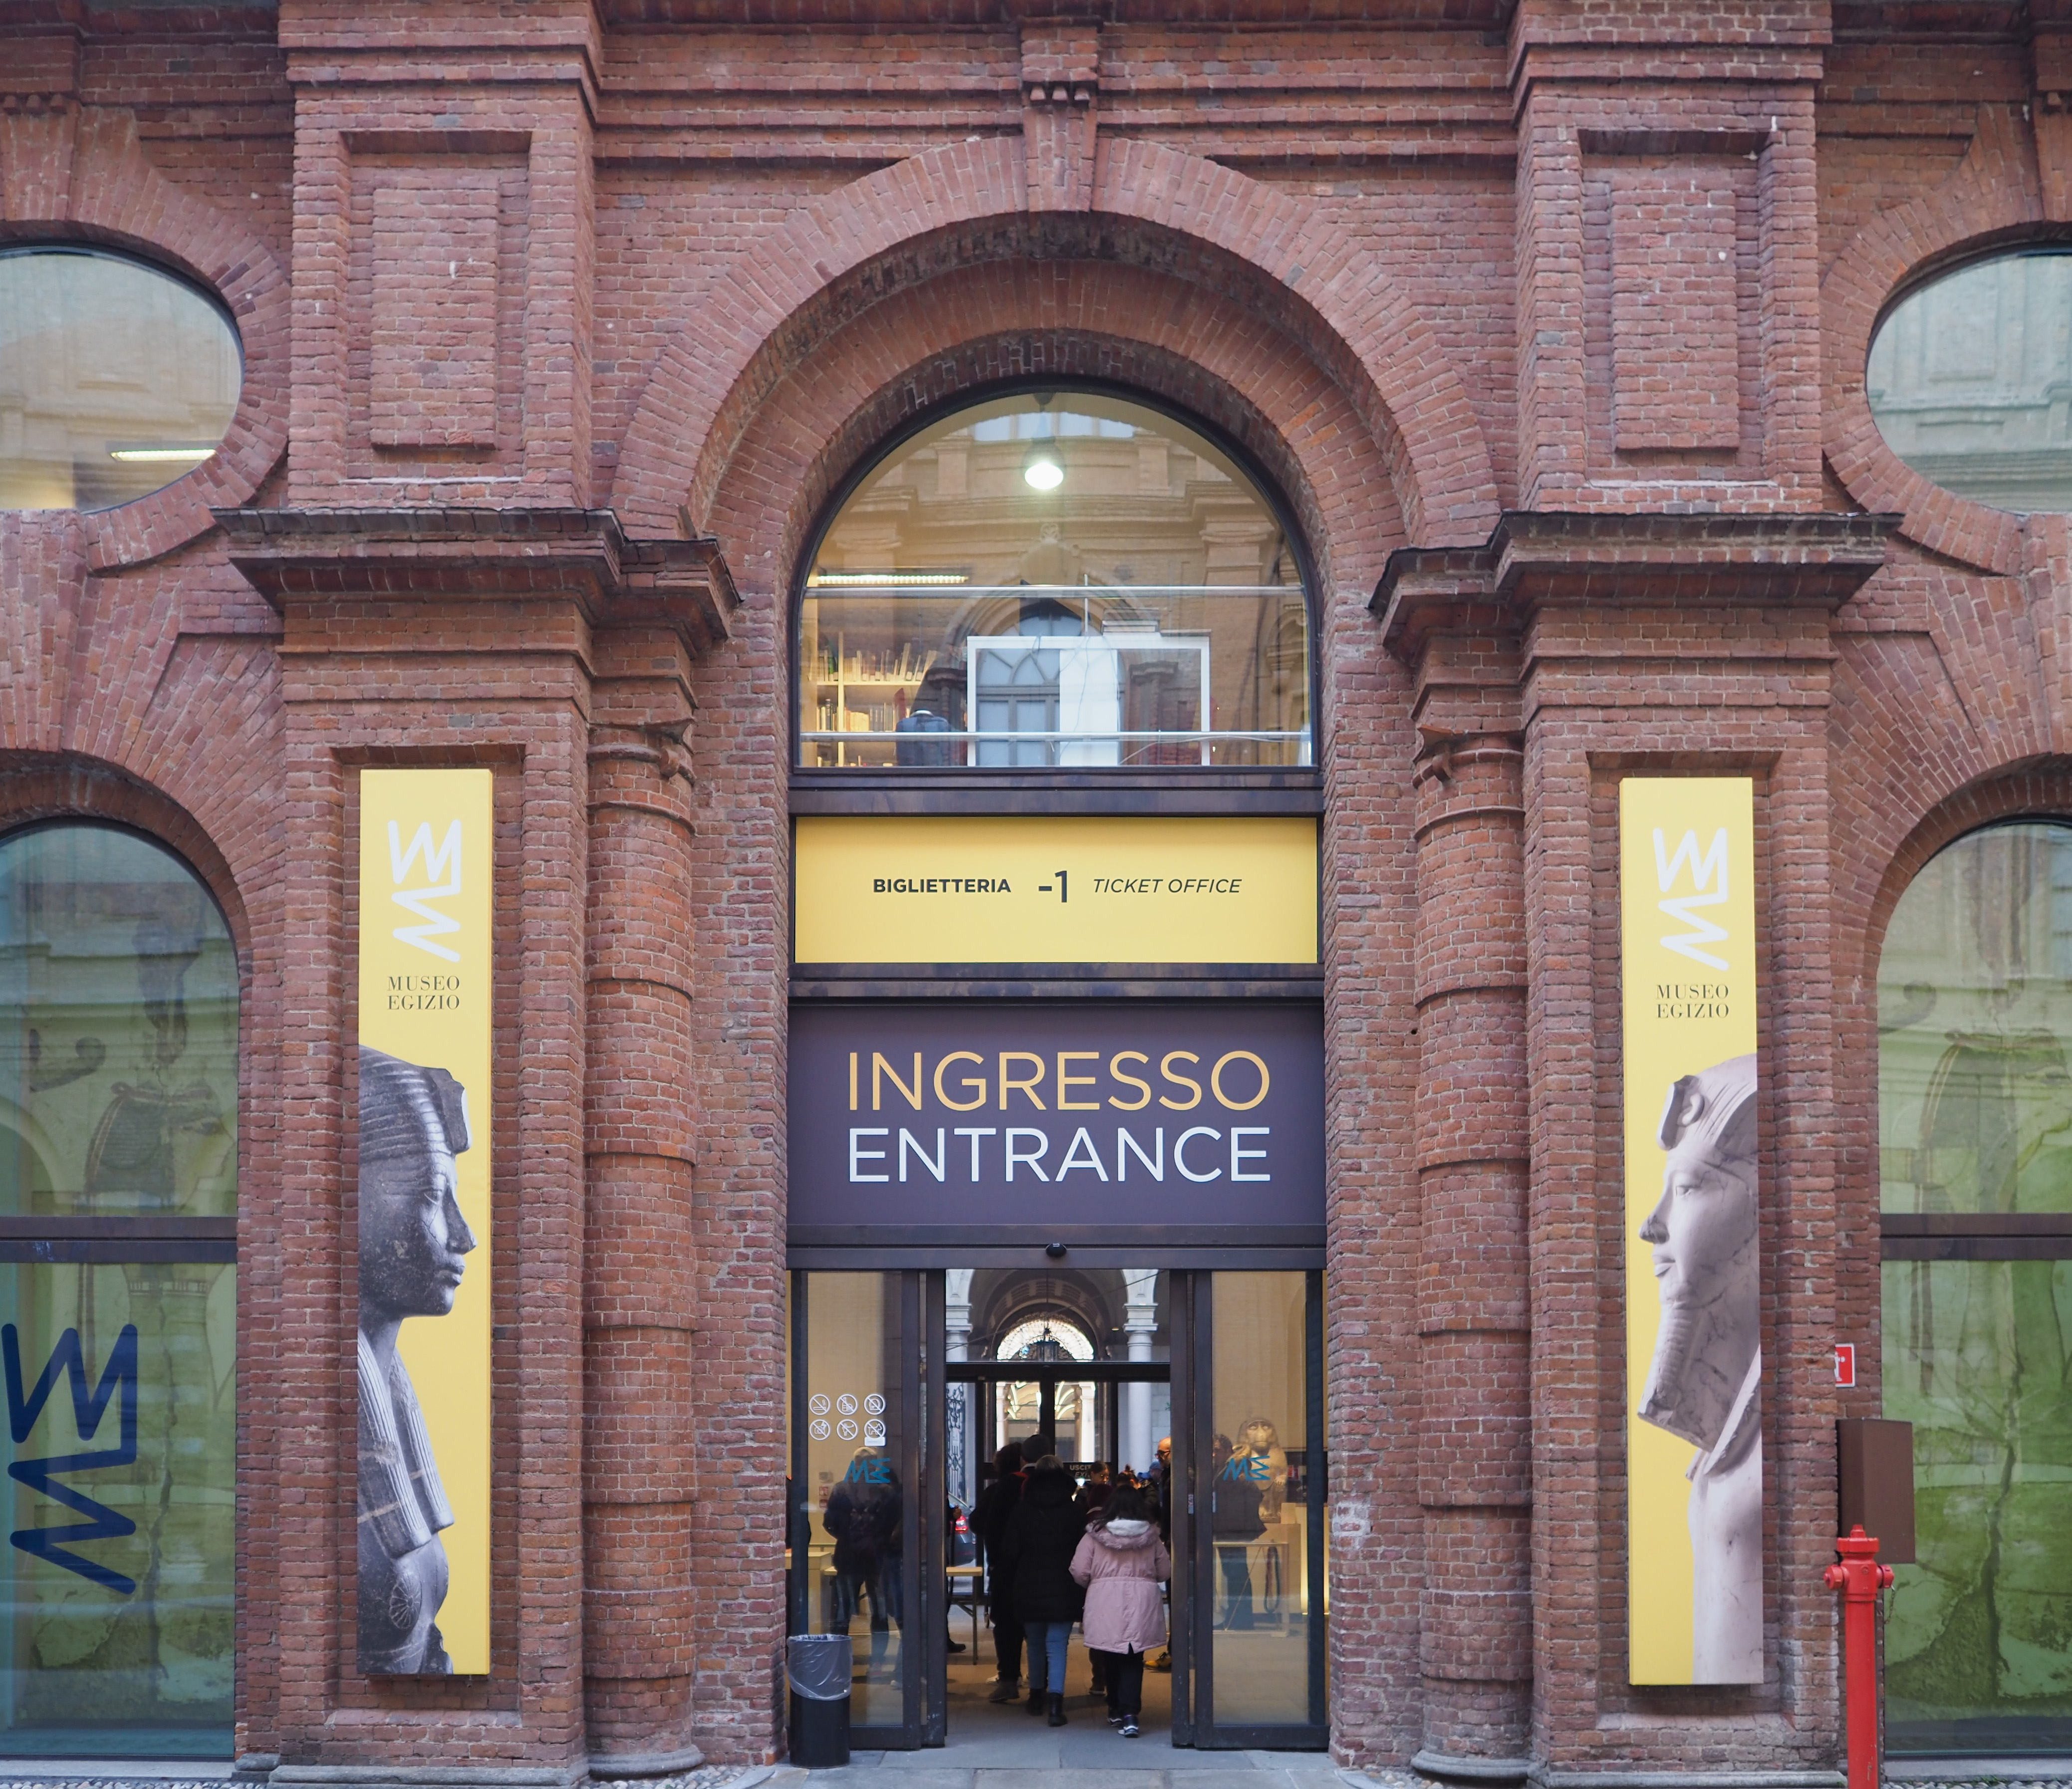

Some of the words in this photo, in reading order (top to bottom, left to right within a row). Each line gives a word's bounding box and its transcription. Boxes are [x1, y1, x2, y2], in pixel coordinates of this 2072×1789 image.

[873, 878, 1011, 893] BIGLIETTERIA
[1038, 870, 1067, 903] -1
[1093, 879, 1164, 893] TICKET
[1168, 878, 1242, 893] OFFICE
[387, 976, 460, 991] MUSEO
[1656, 984, 1729, 999] MUSEO
[387, 995, 460, 1011] EGIZIO
[1656, 1004, 1729, 1019] EGIZIO
[849, 1050, 1270, 1111] INGRESSO
[849, 1126, 1271, 1182] ENTRANCE
